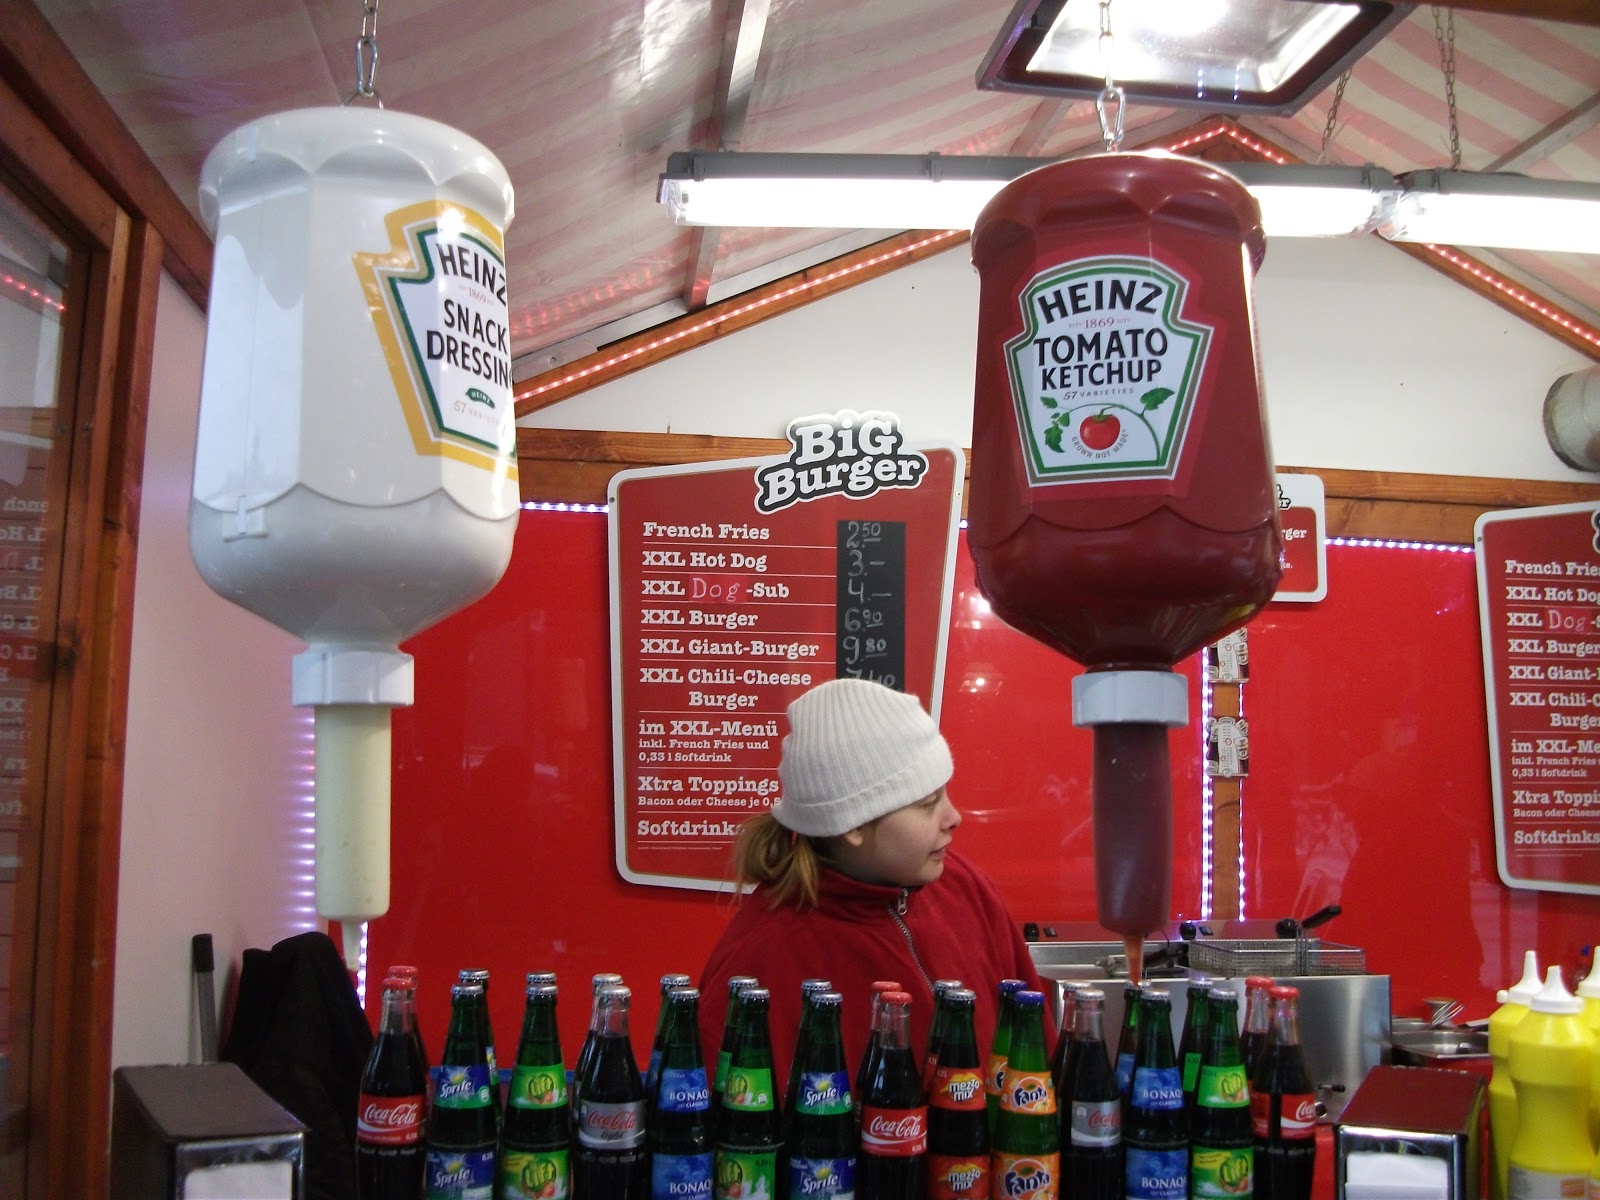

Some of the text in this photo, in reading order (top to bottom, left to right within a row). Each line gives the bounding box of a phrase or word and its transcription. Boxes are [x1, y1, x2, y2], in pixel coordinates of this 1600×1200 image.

[436, 243, 507, 307] HEINZ
[1037, 279, 1163, 324] HEINZ
[444, 298, 508, 355] SNACK
[1084, 317, 1115, 329] 1869
[1033, 327, 1168, 367] TOMATO
[1041, 359, 1162, 391] KETCHUP
[1064, 388, 1135, 400] 57 VARIETIES
[1071, 436, 1093, 458] GROWN
[1095, 450, 1111, 459] NOT
[763, 456, 920, 506] Burger
[643, 522, 770, 540] French Fries
[642, 551, 768, 572] XXL Hot Dog
[1505, 560, 1562, 575] French
[641, 577, 789, 602] XXL Dog -Sub
[1505, 586, 1541, 601] XXL
[1544, 587, 1574, 602] Hot
[641, 610, 758, 630] XXL Burger
[1506, 612, 1542, 627] XXL
[1548, 609, 1586, 632] Dog
[640, 639, 819, 660] XXL Giant-Burger
[1508, 639, 1543, 653] XXL
[640, 668, 812, 686] XXL Chili-Cheese
[1509, 665, 1544, 680] XXL
[689, 691, 758, 710] Burger
[1509, 692, 1600, 707] XXL Chili-C
[639, 719, 779, 737] im XXL-Menü
[639, 738, 770, 750] inkl. French Fries und
[1511, 738, 1600, 753] im XXL-Me
[638, 752, 665, 763] 0,33
[674, 752, 732, 762] Softdrink
[1511, 755, 1534, 765] inkl.
[1536, 756, 1569, 766] French
[1572, 756, 1596, 766] Fries
[1512, 768, 1533, 778] 0,33
[1541, 768, 1587, 778] Softdrink
[638, 776, 779, 796] Xtra Toppings
[638, 796, 674, 806] Bacon
[677, 796, 703, 806] oder
[706, 797, 747, 807] Cheese
[748, 797, 760, 808] je
[1512, 790, 1600, 807] Xtra Toppi
[1513, 808, 1600, 818] Bacon oder Cheese
[1514, 829, 1600, 845] Softdrinks
[440, 1081, 472, 1098] Sprite
[949, 1078, 980, 1093] mezzo
[669, 1089, 709, 1101] BONAQ
[805, 1086, 836, 1106] Sprite
[953, 1090, 974, 1101] mix
[1014, 1086, 1047, 1106] Fanta
[364, 1103, 419, 1125] Coca-Cola
[587, 1110, 637, 1130] Coca-Cola
[870, 1115, 923, 1137] Coca-Cola
[433, 1168, 470, 1188] Sprite
[802, 1175, 838, 1194] Sprite
[948, 1168, 981, 1183] mezzo
[1005, 1170, 1050, 1197] Fanta
[669, 1178, 713, 1194] BONAQ
[952, 1180, 974, 1192] mix
